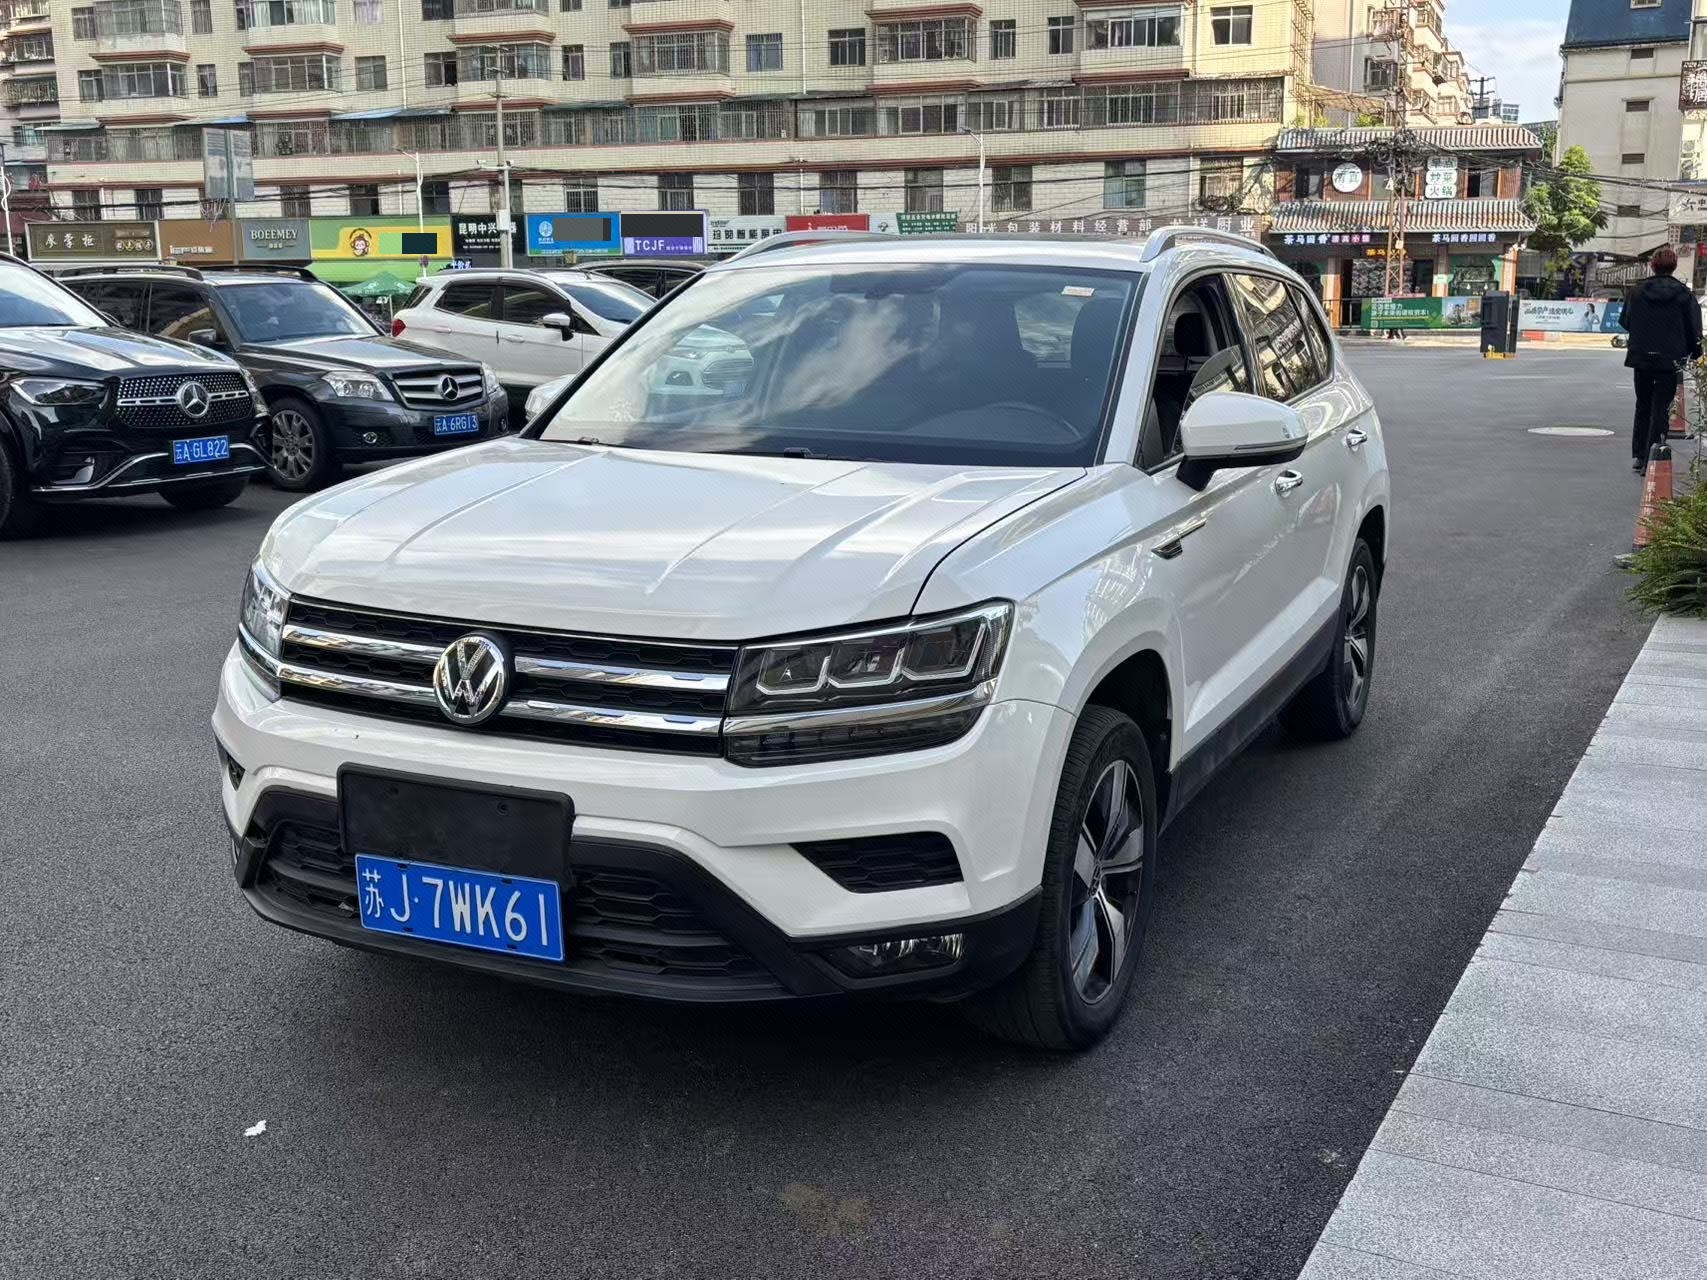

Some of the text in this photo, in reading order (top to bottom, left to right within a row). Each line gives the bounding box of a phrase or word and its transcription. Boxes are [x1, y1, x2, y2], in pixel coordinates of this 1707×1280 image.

[1430, 172, 1454, 183] 炒菜
[1430, 185, 1453, 197] 火锅
[634, 240, 665, 251] TCJF
